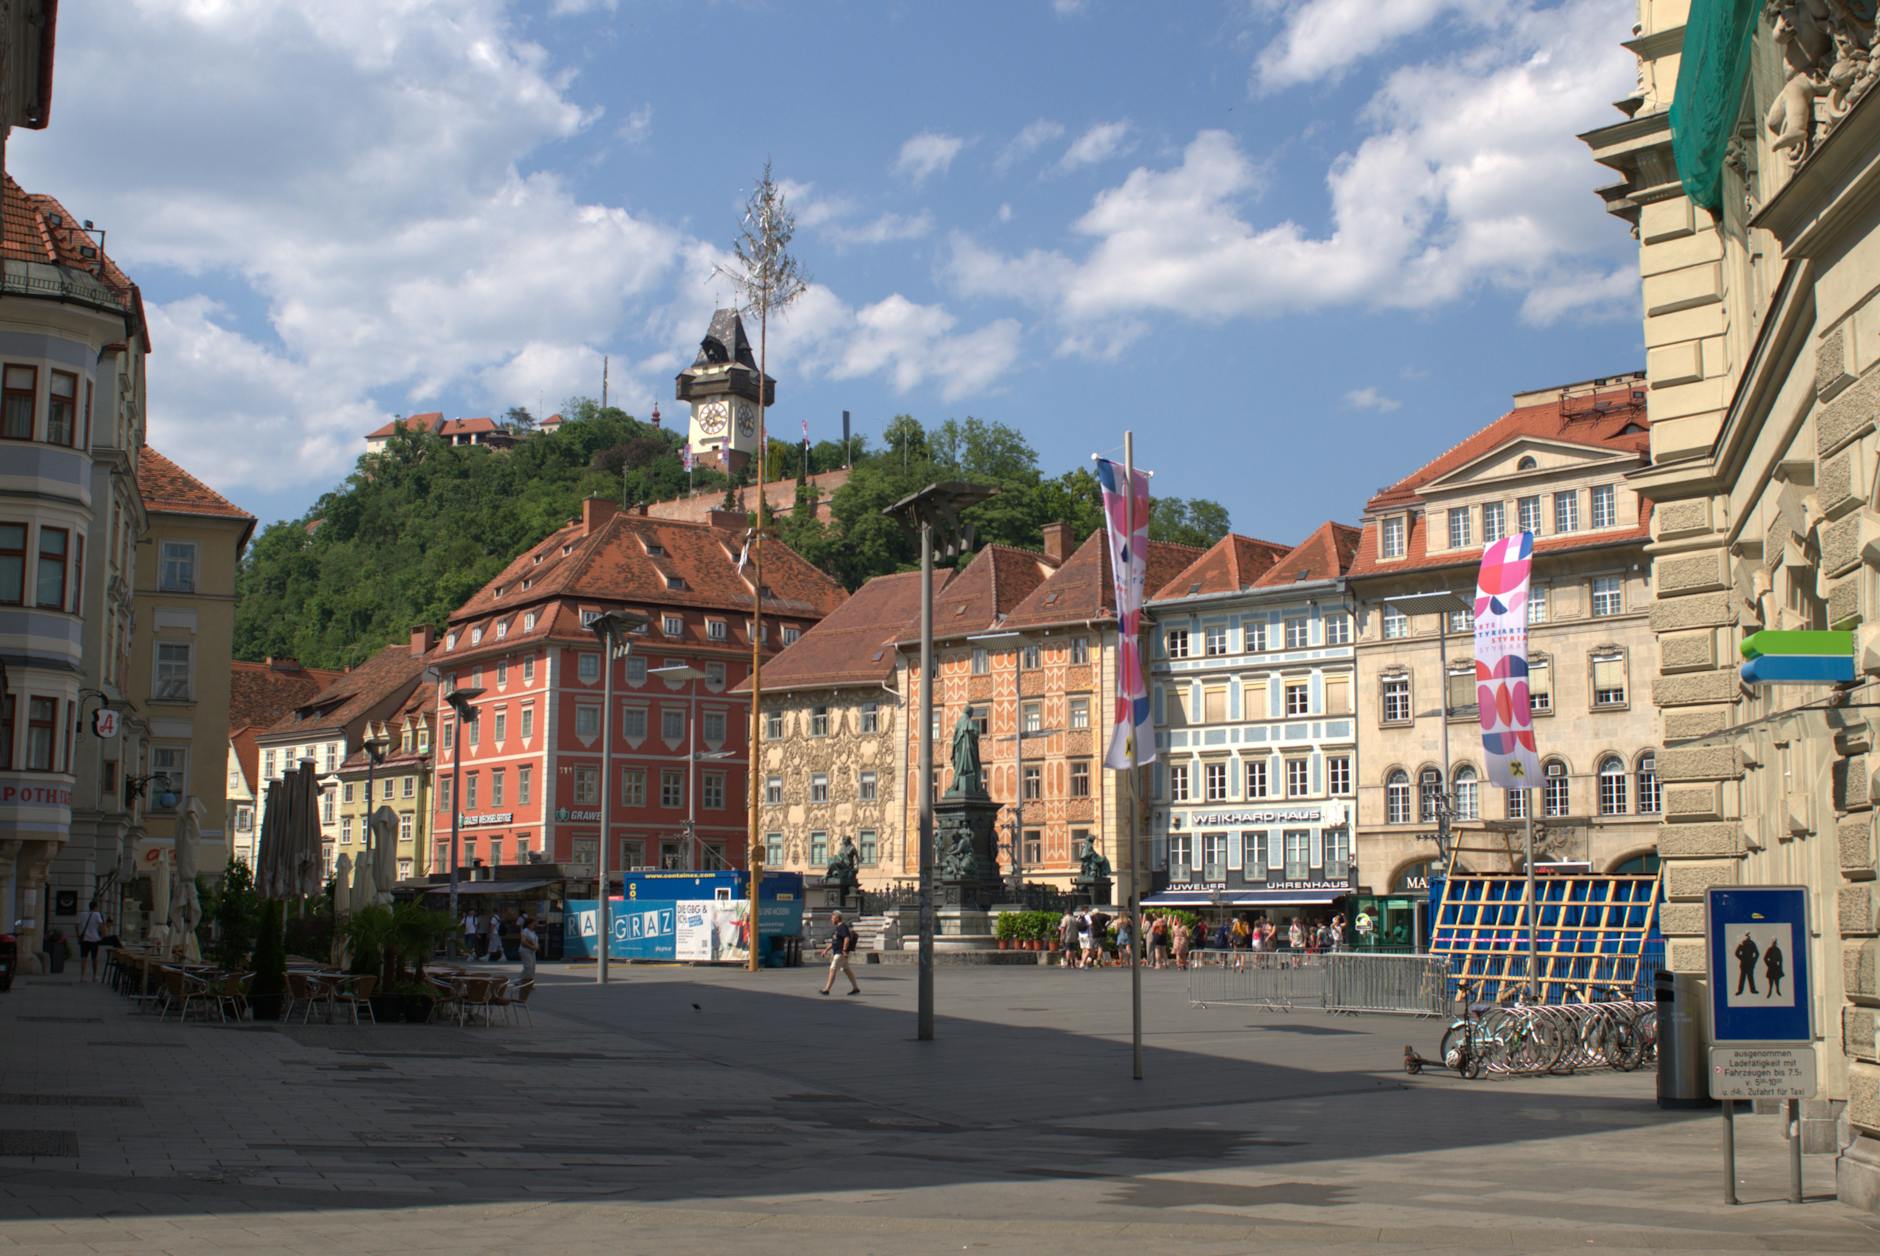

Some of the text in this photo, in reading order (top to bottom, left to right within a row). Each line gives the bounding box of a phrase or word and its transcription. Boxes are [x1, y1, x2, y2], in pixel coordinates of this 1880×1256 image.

[1192, 810, 1321, 824] WEIKHARD HAUS
[1266, 881, 1350, 889] UHRENHAUS
[615, 911, 672, 939] GRAZ
[1734, 1050, 1792, 1058] ausgenommen
[1729, 1059, 1797, 1069] Ladetätigkeit mit
[1724, 1069, 1771, 1077] Fahrzeugen
[1747, 1088, 1774, 1096] Zufahrt
[1777, 1088, 1788, 1096] für
[1790, 1088, 1805, 1096] Taxi
